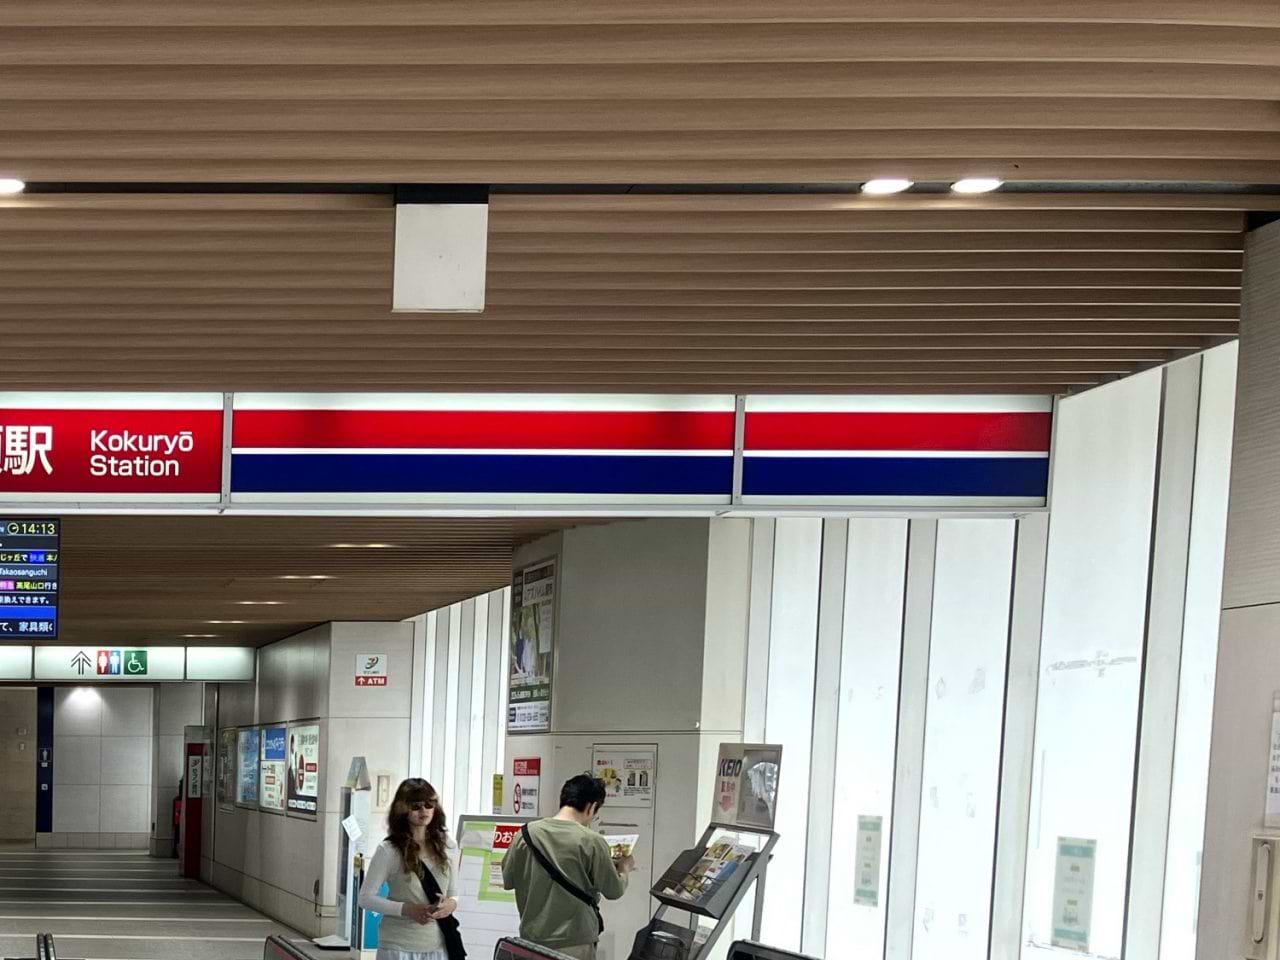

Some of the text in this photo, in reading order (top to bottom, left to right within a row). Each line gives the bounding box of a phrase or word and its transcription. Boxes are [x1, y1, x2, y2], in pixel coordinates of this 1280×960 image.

[90, 429, 194, 454] Kokuryō
[90, 454, 180, 477] Station
[22, 523, 55, 535] 14:13
[0, 567, 48, 577] Takaosanguchi
[718, 759, 743, 777] KEIO
